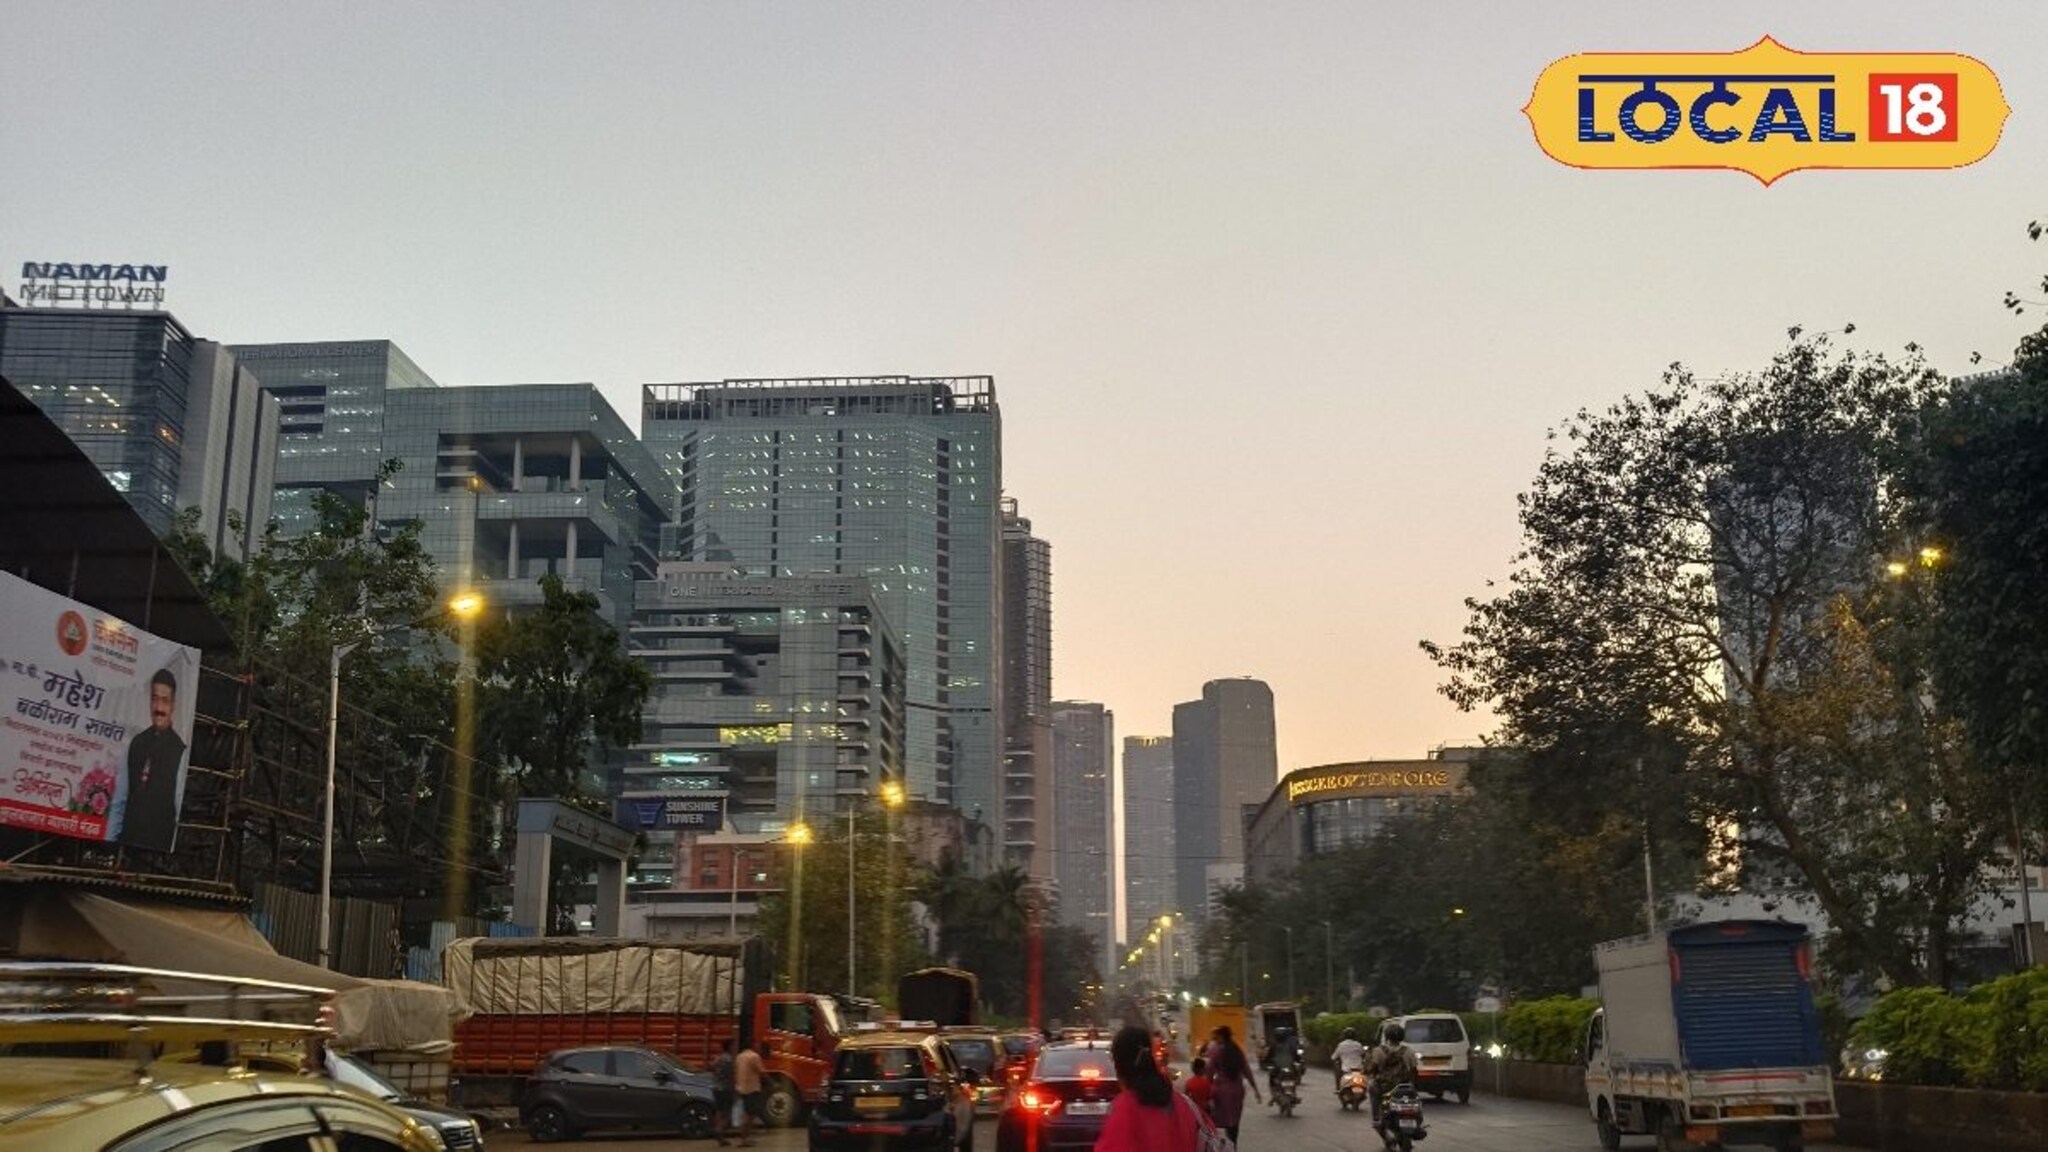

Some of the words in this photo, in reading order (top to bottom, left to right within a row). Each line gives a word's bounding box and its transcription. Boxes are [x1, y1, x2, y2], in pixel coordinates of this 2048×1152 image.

[22, 262, 168, 282] NAMAN
[670, 586, 697, 598] ONE
[42, 669, 106, 710] महेश
[16, 697, 80, 729] बळीराम
[85, 716, 126, 742] सावंत
[665, 801, 719, 812] SUNSHINE
[665, 813, 704, 824] TOWER
